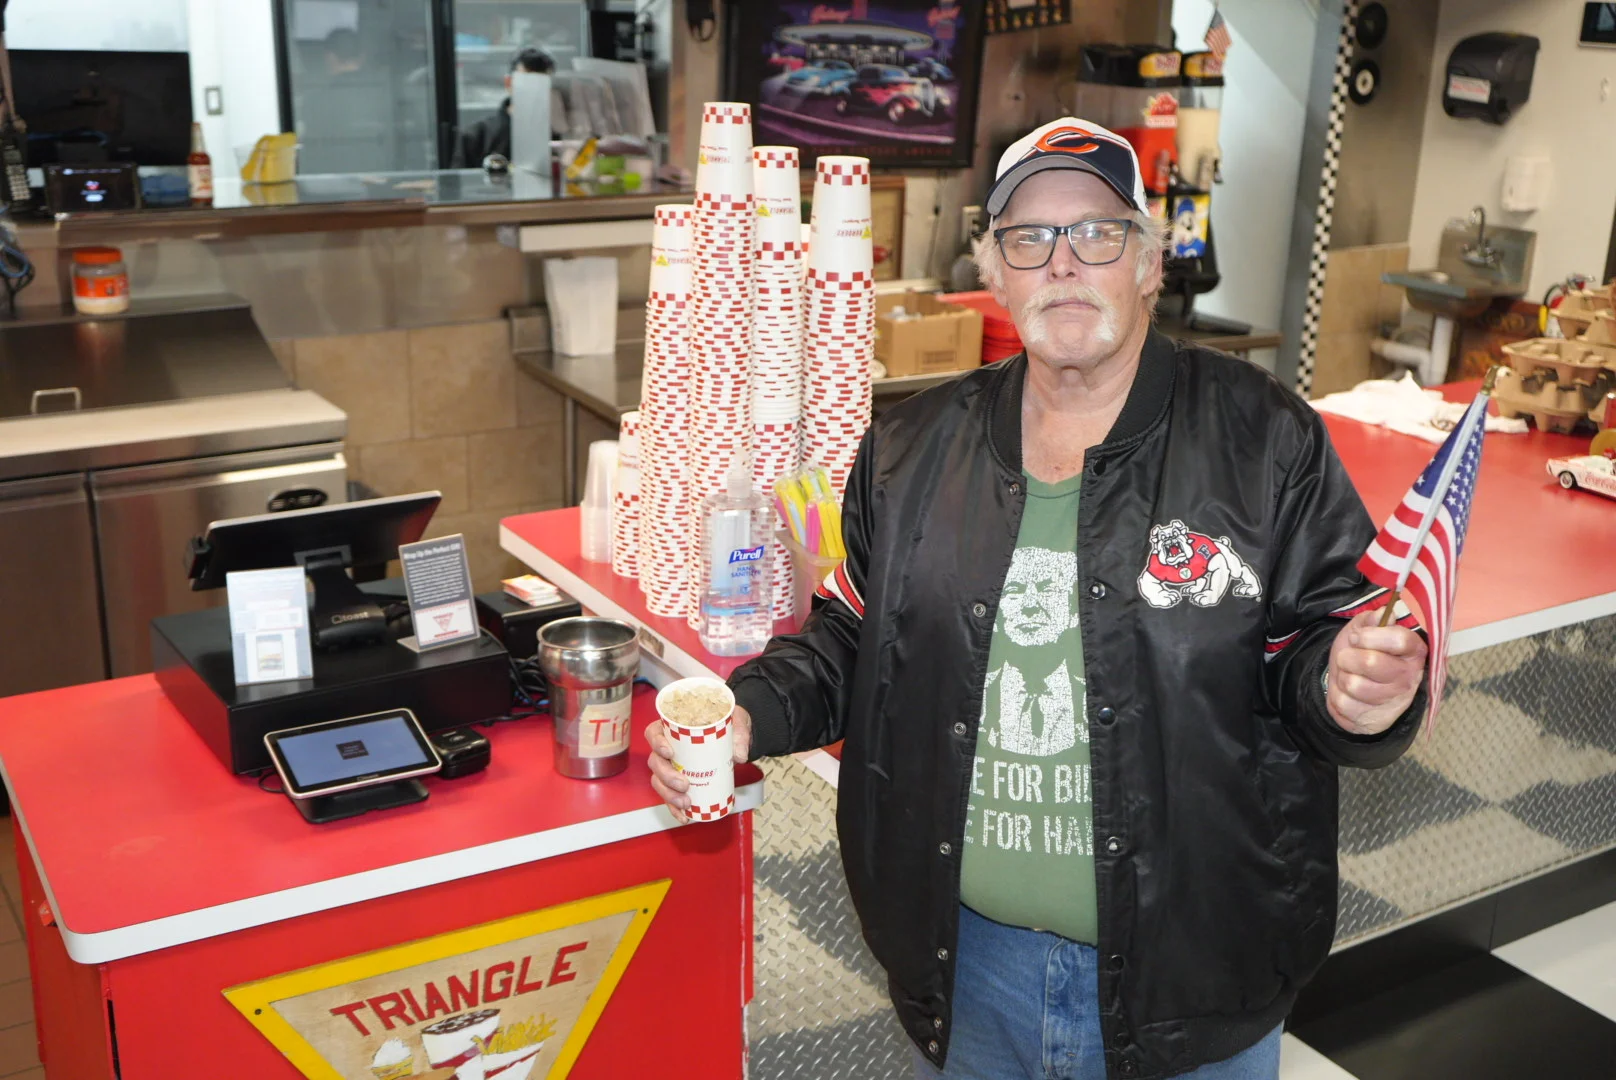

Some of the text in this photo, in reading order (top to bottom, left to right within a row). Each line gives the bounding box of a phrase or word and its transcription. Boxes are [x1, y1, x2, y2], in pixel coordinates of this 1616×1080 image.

[993, 760, 1043, 803] FOR
[982, 808, 1032, 853] FOR
[329, 941, 589, 1037] TRIANGLE
